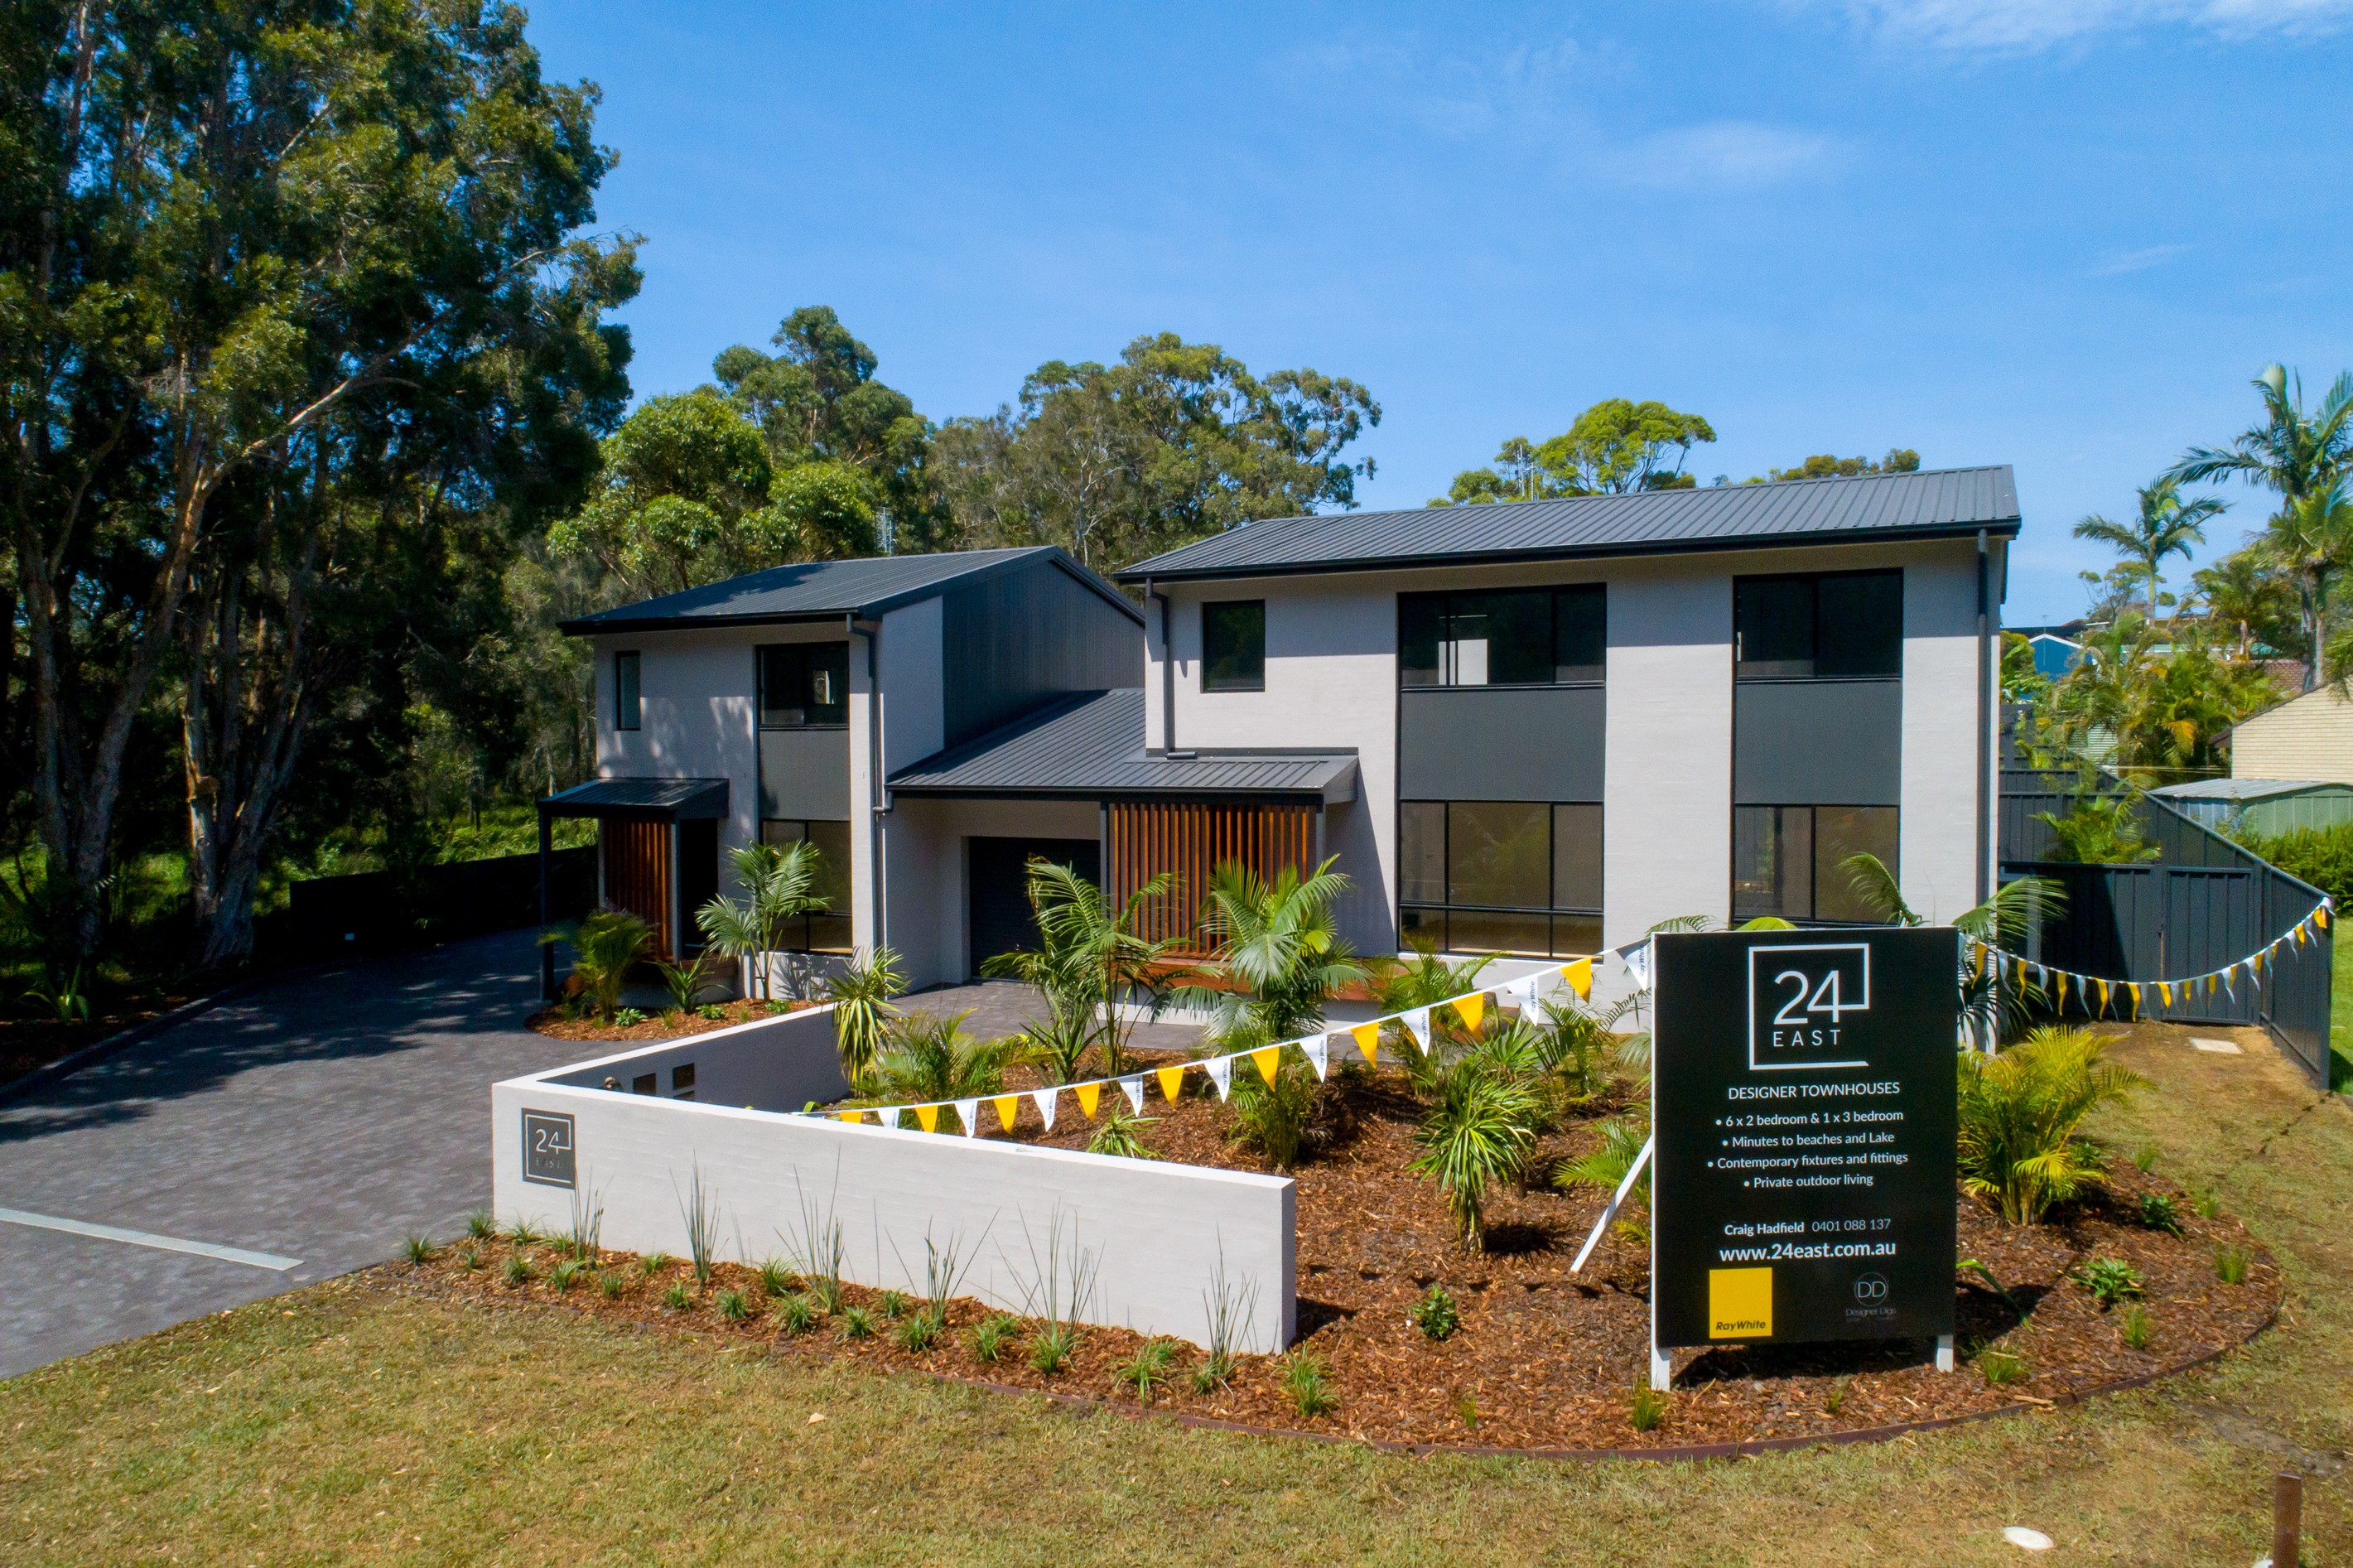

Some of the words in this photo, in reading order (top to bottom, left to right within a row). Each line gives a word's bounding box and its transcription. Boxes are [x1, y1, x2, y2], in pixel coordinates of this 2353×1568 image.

[1773, 969, 1839, 1025] 24
[1773, 1030, 1840, 1047] EAST
[1729, 1086, 1796, 1099] DESIGNER
[1800, 1082, 1900, 1097] TOWNHOUSES
[1726, 1116, 1733, 1127] 6
[1746, 1115, 1753, 1126] 2
[1757, 1114, 1807, 1126] bedroom
[1811, 1113, 1820, 1123] &
[1824, 1112, 1830, 1123] 1
[1843, 1112, 1850, 1122] 3
[1854, 1111, 1903, 1122] bedroom
[536, 1128, 558, 1154] 24
[1733, 1136, 1778, 1147] Minutes
[1782, 1136, 1793, 1146] to
[1797, 1134, 1842, 1145] beaches
[1845, 1132, 1865, 1144] and
[1869, 1132, 1894, 1143] Lake
[1718, 1158, 1799, 1169] Contemporary
[1801, 1155, 1843, 1165] fixtures
[1846, 1153, 1867, 1164] and
[1870, 1152, 1908, 1165] fittings
[1754, 1177, 1793, 1188] Private
[1796, 1175, 1841, 1186] outdoor
[1844, 1174, 1873, 1186] living
[1724, 1224, 1754, 1237] Craig
[1758, 1222, 1804, 1234] Hadfield
[1812, 1221, 1839, 1232] 0401
[1844, 1220, 1866, 1230] 088
[1869, 1218, 1891, 1229] 137
[1719, 1243, 1896, 1262] www.24east.com.au
[1858, 1281, 1886, 1298] DD
